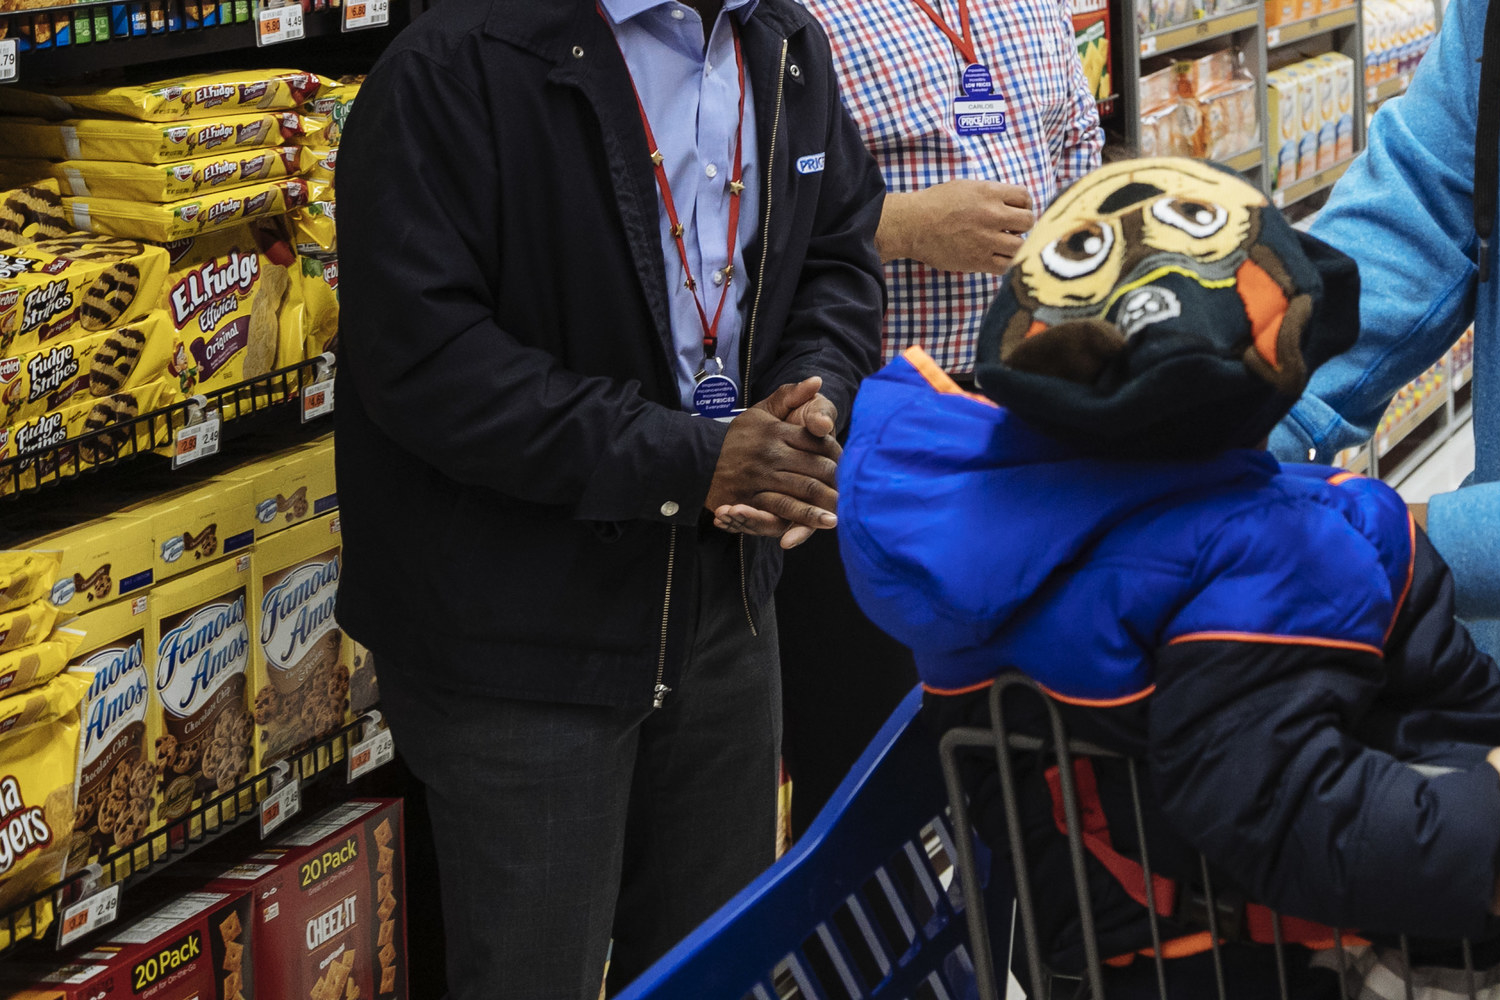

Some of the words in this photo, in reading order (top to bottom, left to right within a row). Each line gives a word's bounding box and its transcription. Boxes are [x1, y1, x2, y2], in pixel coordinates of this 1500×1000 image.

[264, 20, 280, 32] $6.80
[351, 5, 366, 16] $6.80
[961, 115, 982, 126] PRICE
[985, 115, 1000, 124] RITE
[800, 157, 825, 171] PRIC
[21, 293, 72, 330] Stripes
[26, 278, 67, 311] Fudge
[200, 293, 238, 332] Elfwich
[206, 323, 239, 360] Original
[29, 346, 72, 380] Fudge
[30, 361, 78, 399] Stripes
[17, 412, 61, 448] Fudge
[261, 556, 338, 645] Famous
[157, 595, 244, 691] Famous
[89, 639, 142, 701] mous
[180, 632, 248, 709] Amos
[85, 679, 148, 752] Amos
[184, 698, 217, 734] Chocolate
[217, 686, 230, 707] Chip
[80, 746, 113, 787] Chocolate
[112, 735, 128, 759] Chip
[0, 807, 48, 872] gers
[302, 859, 320, 886] 20
[323, 840, 357, 872] Pack
[96, 898, 116, 916] $2.49
[135, 959, 158, 990] 20
[160, 936, 199, 975] Pack
[143, 987, 157, 999] Great
[159, 980, 167, 990] for
[167, 964, 196, 984] On-the-Go
